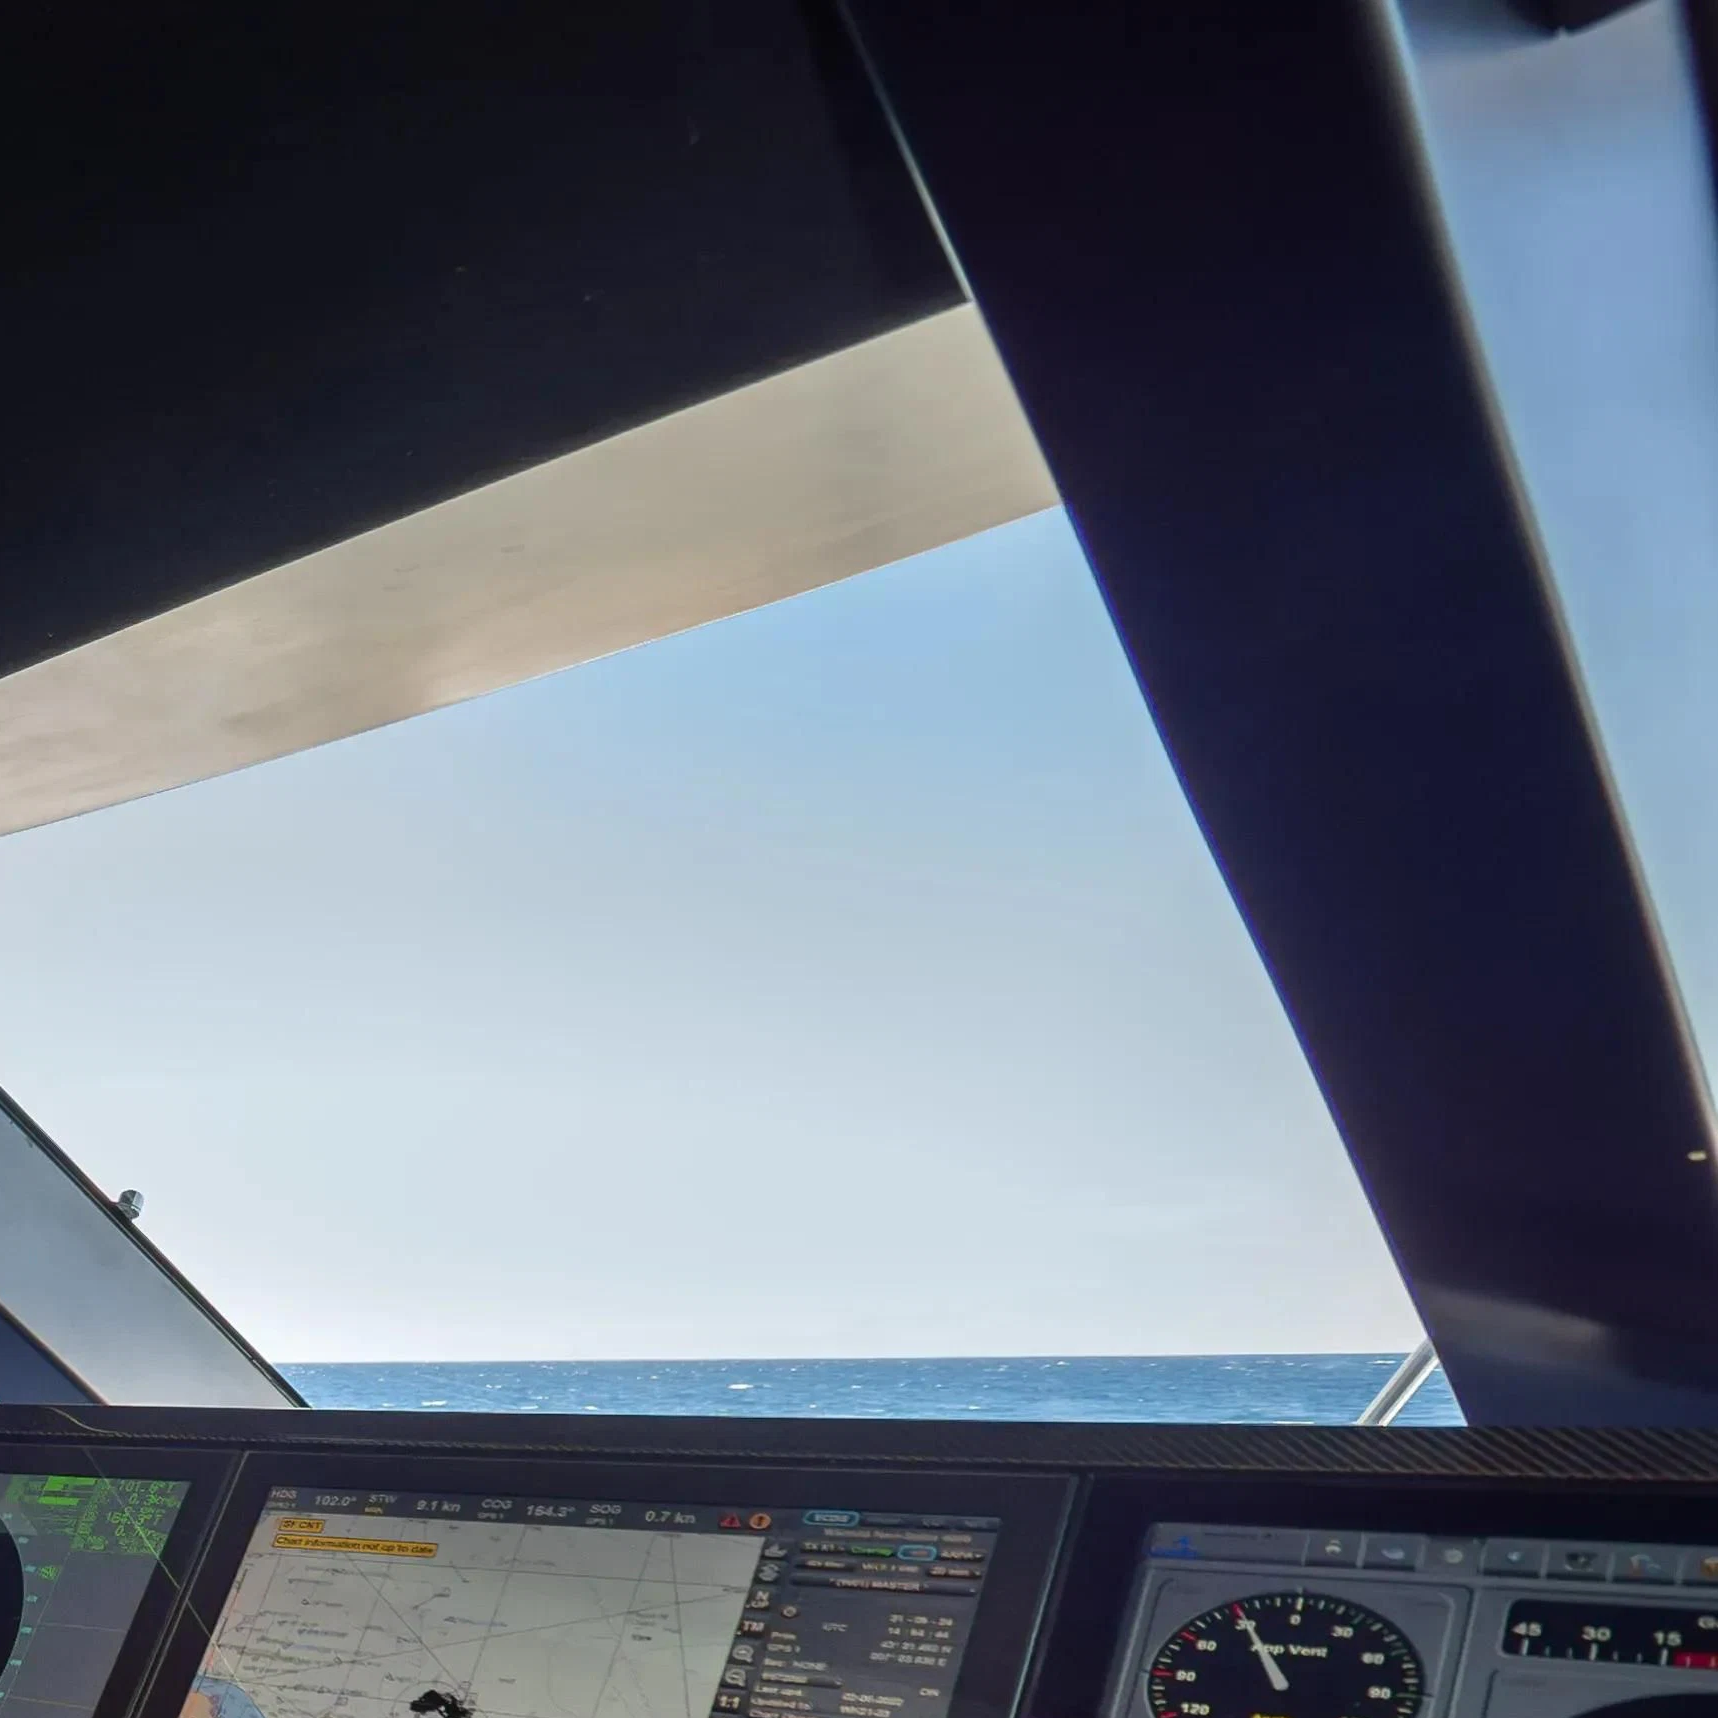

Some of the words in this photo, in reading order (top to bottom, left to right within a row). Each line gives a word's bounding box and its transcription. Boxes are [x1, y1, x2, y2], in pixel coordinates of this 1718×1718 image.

[315, 1495, 357, 1507] 102.0°
[441, 1502, 461, 1513] kn
[481, 1498, 512, 1511] COG
[589, 1503, 622, 1515] SOG
[645, 1510, 669, 1523] 0.7
[673, 1511, 696, 1525] kn
[275, 1536, 303, 1547] Chart
[305, 1538, 361, 1551] information
[362, 1541, 379, 1551] not
[380, 1543, 395, 1554] up
[396, 1543, 409, 1553] to
[1289, 1614, 1301, 1627] 0
[1330, 1625, 1354, 1639] 30
[1512, 1621, 1543, 1637] 45
[1581, 1625, 1612, 1642] 30
[1652, 1630, 1683, 1647] 15
[1287, 1643, 1328, 1658] Vent
[1175, 1670, 1197, 1682] 90
[1367, 1686, 1392, 1700] 90
[1180, 1702, 1210, 1716] 120
